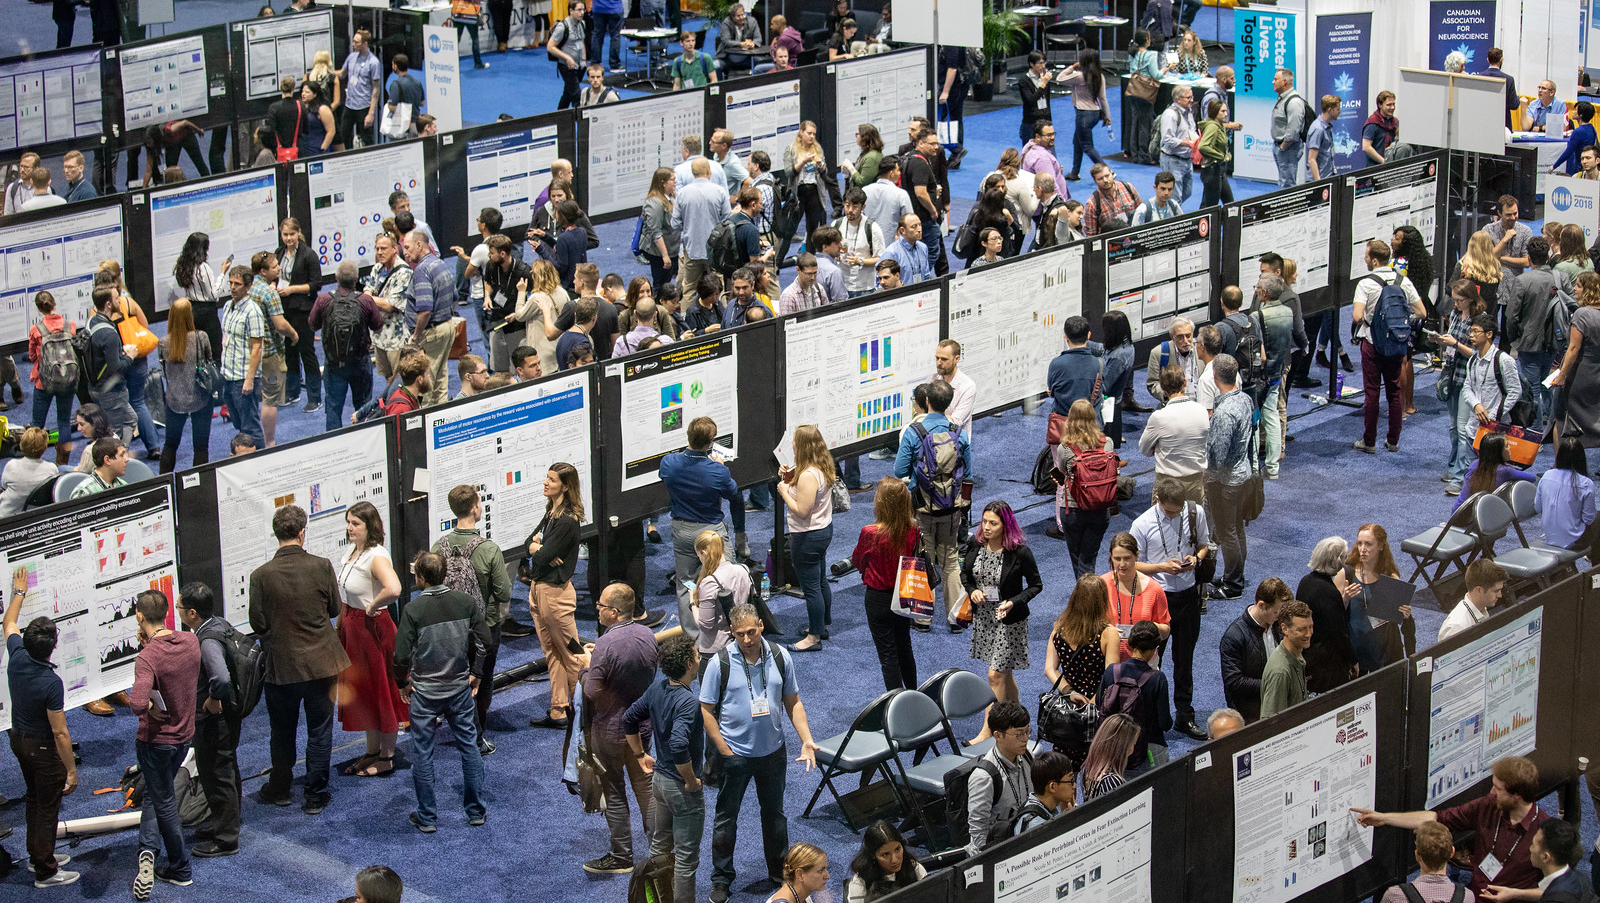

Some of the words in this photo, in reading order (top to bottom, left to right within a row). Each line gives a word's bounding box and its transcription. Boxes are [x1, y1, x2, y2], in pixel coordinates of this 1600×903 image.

[1260, 16, 1273, 63] Lives.
[1241, 16, 1257, 92] Together.
[430, 61, 454, 72] Dynamic
[434, 74, 451, 84] Poster
[440, 87, 447, 96] 13
[1574, 199, 1592, 209] 2018
[438, 425, 458, 433] Modulation
[473, 416, 491, 424] resonance
[526, 401, 544, 409] associated
[433, 418, 445, 427] ETH
[15, 529, 27, 537] single
[37, 522, 52, 531] activity
[53, 517, 72, 526] encoding
[77, 510, 96, 519] outcome
[96, 503, 118, 515] probability
[119, 497, 141, 508] estimation
[1356, 701, 1372, 715] EPSRC
[1347, 720, 1362, 729] wellcome
[1195, 757, 1207, 765] CCC3
[1011, 859, 1031, 872] Possible
[1032, 854, 1043, 863] Role
[1052, 838, 1075, 854] Perirhinal
[1076, 832, 1090, 843] Cortex
[1097, 823, 1106, 832] Fear
[1108, 812, 1128, 826] Extinction
[1129, 802, 1146, 815] Learning
[1034, 863, 1046, 871] Nicole
